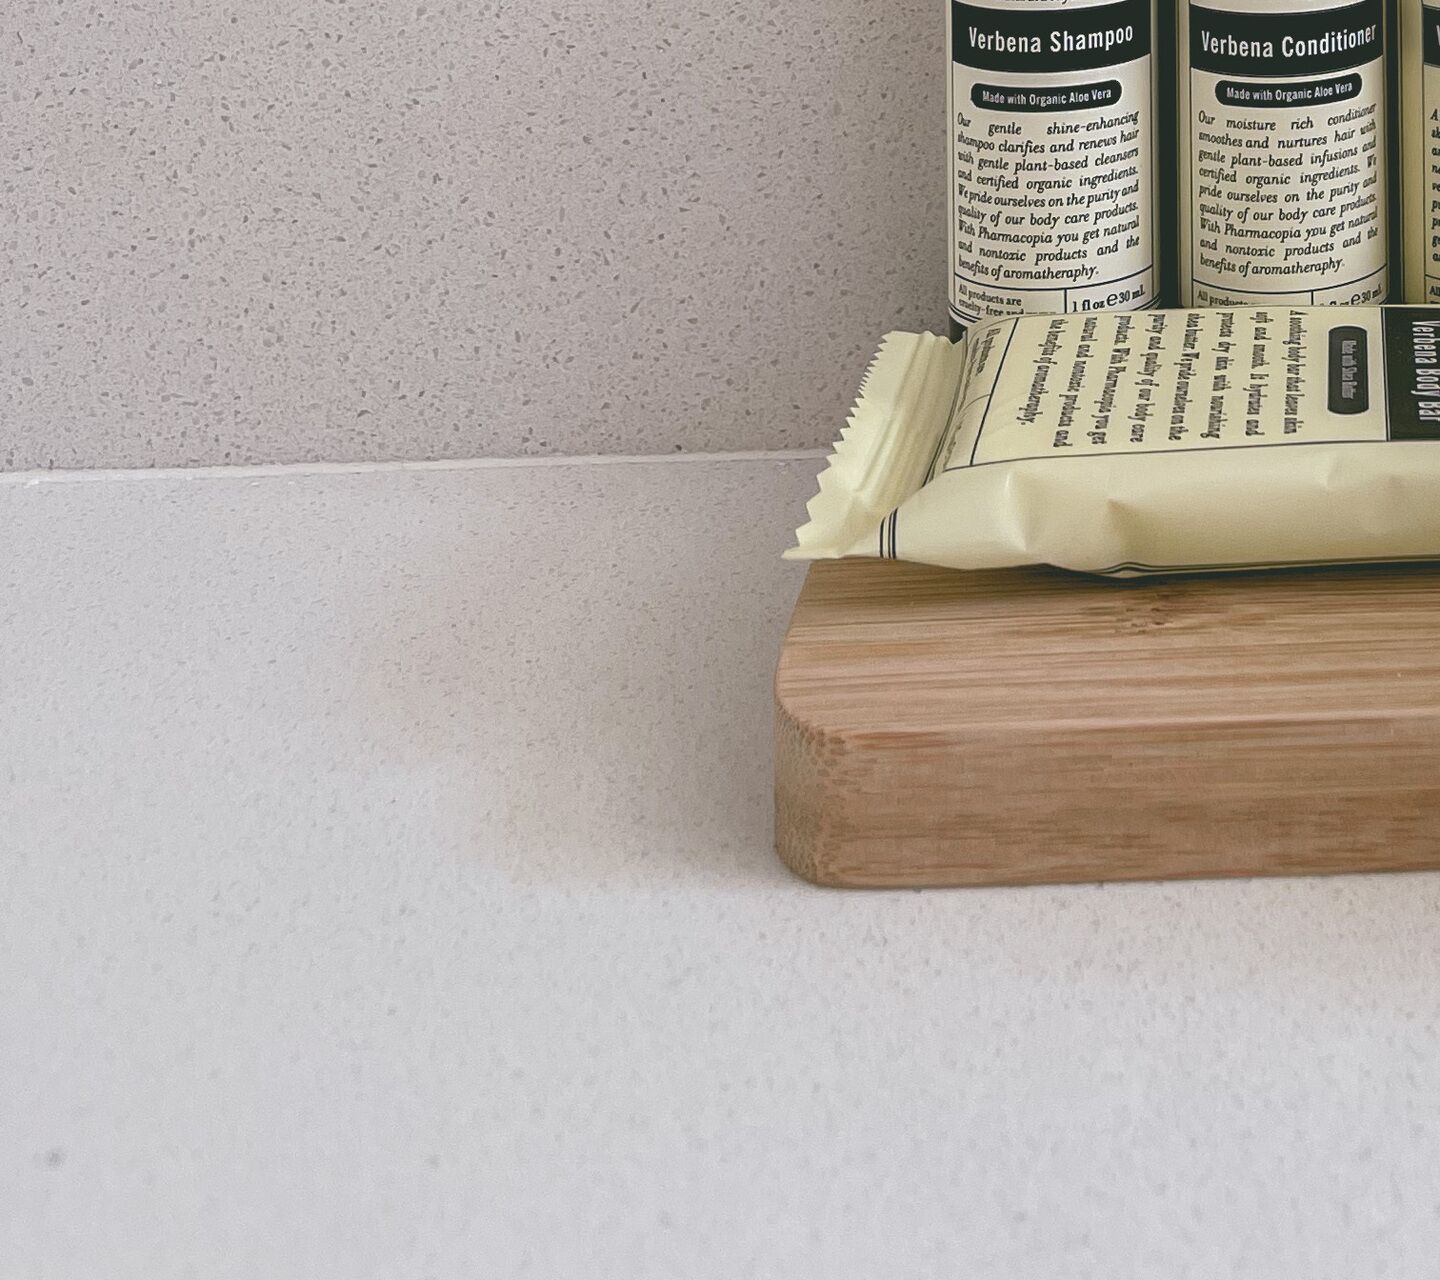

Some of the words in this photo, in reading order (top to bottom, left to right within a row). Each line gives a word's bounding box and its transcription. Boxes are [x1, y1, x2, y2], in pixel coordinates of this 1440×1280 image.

[969, 26, 1041, 53] Verbena
[1050, 25, 1133, 53] Shampoo
[1201, 30, 1273, 58] Verbena
[1281, 24, 1376, 58] Conditioner
[982, 91, 1004, 103] Made
[1007, 94, 1027, 105] with
[1029, 94, 1066, 107] Organic
[1069, 92, 1089, 103] Aloe
[1091, 88, 1112, 100] Vera
[1227, 88, 1250, 100] Made
[1253, 90, 1273, 100] with
[1275, 89, 1312, 102] Organic
[1314, 87, 1333, 97] Aloe
[1335, 82, 1352, 94] Vera
[988, 122, 1022, 136] gentle
[1047, 111, 1139, 135] shine-enhancing
[1199, 110, 1215, 124] Our
[1226, 118, 1276, 131] moisture
[1291, 117, 1314, 129] rich
[1430, 109, 1439, 121] A
[998, 140, 1045, 157] clarifies
[1050, 139, 1074, 153] and
[1078, 138, 1116, 151] renews
[1120, 128, 1139, 144] hair
[1199, 131, 1242, 148] smoothes
[1246, 136, 1269, 149] and
[1277, 135, 1327, 148] nurtures
[1334, 128, 1355, 143] hair
[978, 157, 1009, 170] gentle
[1014, 156, 1088, 174] plant-based
[1095, 147, 1139, 166] cleansers
[1199, 149, 1226, 163] gentle
[1230, 154, 1303, 168] plant-based
[1310, 147, 1358, 167] infusions
[977, 175, 1018, 191] certified
[1027, 178, 1072, 193] organic
[1080, 166, 1138, 189] ingredients.
[1199, 168, 1237, 184] certified
[1246, 173, 1291, 188] organic
[1300, 165, 1360, 186] ingredients.
[969, 189, 992, 204] pride
[994, 194, 1045, 207] ourselves
[1049, 198, 1063, 207] on
[1066, 193, 1085, 206] the
[1086, 189, 1119, 208] purity
[1122, 179, 1139, 196] and
[1199, 184, 1222, 198] pride
[1227, 190, 1278, 204] ourselves
[1285, 195, 1299, 203] on
[1306, 188, 1324, 201] the
[1329, 182, 1360, 202] purity
[990, 211, 1002, 227] of
[1005, 215, 1025, 225] our
[1030, 214, 1059, 229] body
[1064, 213, 1089, 224] care
[1200, 203, 1233, 221] quality
[1237, 207, 1250, 223] of
[1253, 211, 1274, 220] our
[1278, 208, 1309, 224] body
[1312, 207, 1336, 218] care
[978, 226, 1052, 248] Pharmacopia
[1056, 234, 1078, 247] you
[1082, 230, 1100, 244] get
[1103, 215, 1140, 237] natural
[1200, 218, 1221, 234] With
[1224, 223, 1301, 242] Pharmacopia
[1305, 226, 1326, 240] you
[1330, 222, 1345, 237] get
[979, 247, 1026, 261] nontoxic
[1035, 249, 1087, 265] products
[1097, 241, 1119, 256] and
[1126, 235, 1140, 249] the
[1200, 239, 1217, 251] and
[1226, 245, 1275, 257] nontoxic
[1284, 242, 1334, 260] products
[1342, 232, 1361, 248] and
[991, 264, 1003, 281] of
[1004, 265, 1099, 282] aromatheraphy.
[1200, 254, 1236, 274] benefits
[1238, 261, 1251, 277] of
[1006, 298, 1022, 306] are
[1073, 301, 1077, 312] 1
[1082, 299, 1090, 311] fl
[1093, 300, 1105, 310] oz
[1119, 291, 1130, 303] 30
[1283, 318, 1307, 345] soothing
[1281, 346, 1307, 362] body
[1287, 364, 1306, 375] bar
[1341, 367, 1357, 381] Shea
[1287, 376, 1305, 392] that
[1285, 394, 1305, 415] leaves
[1284, 417, 1304, 434] skin
